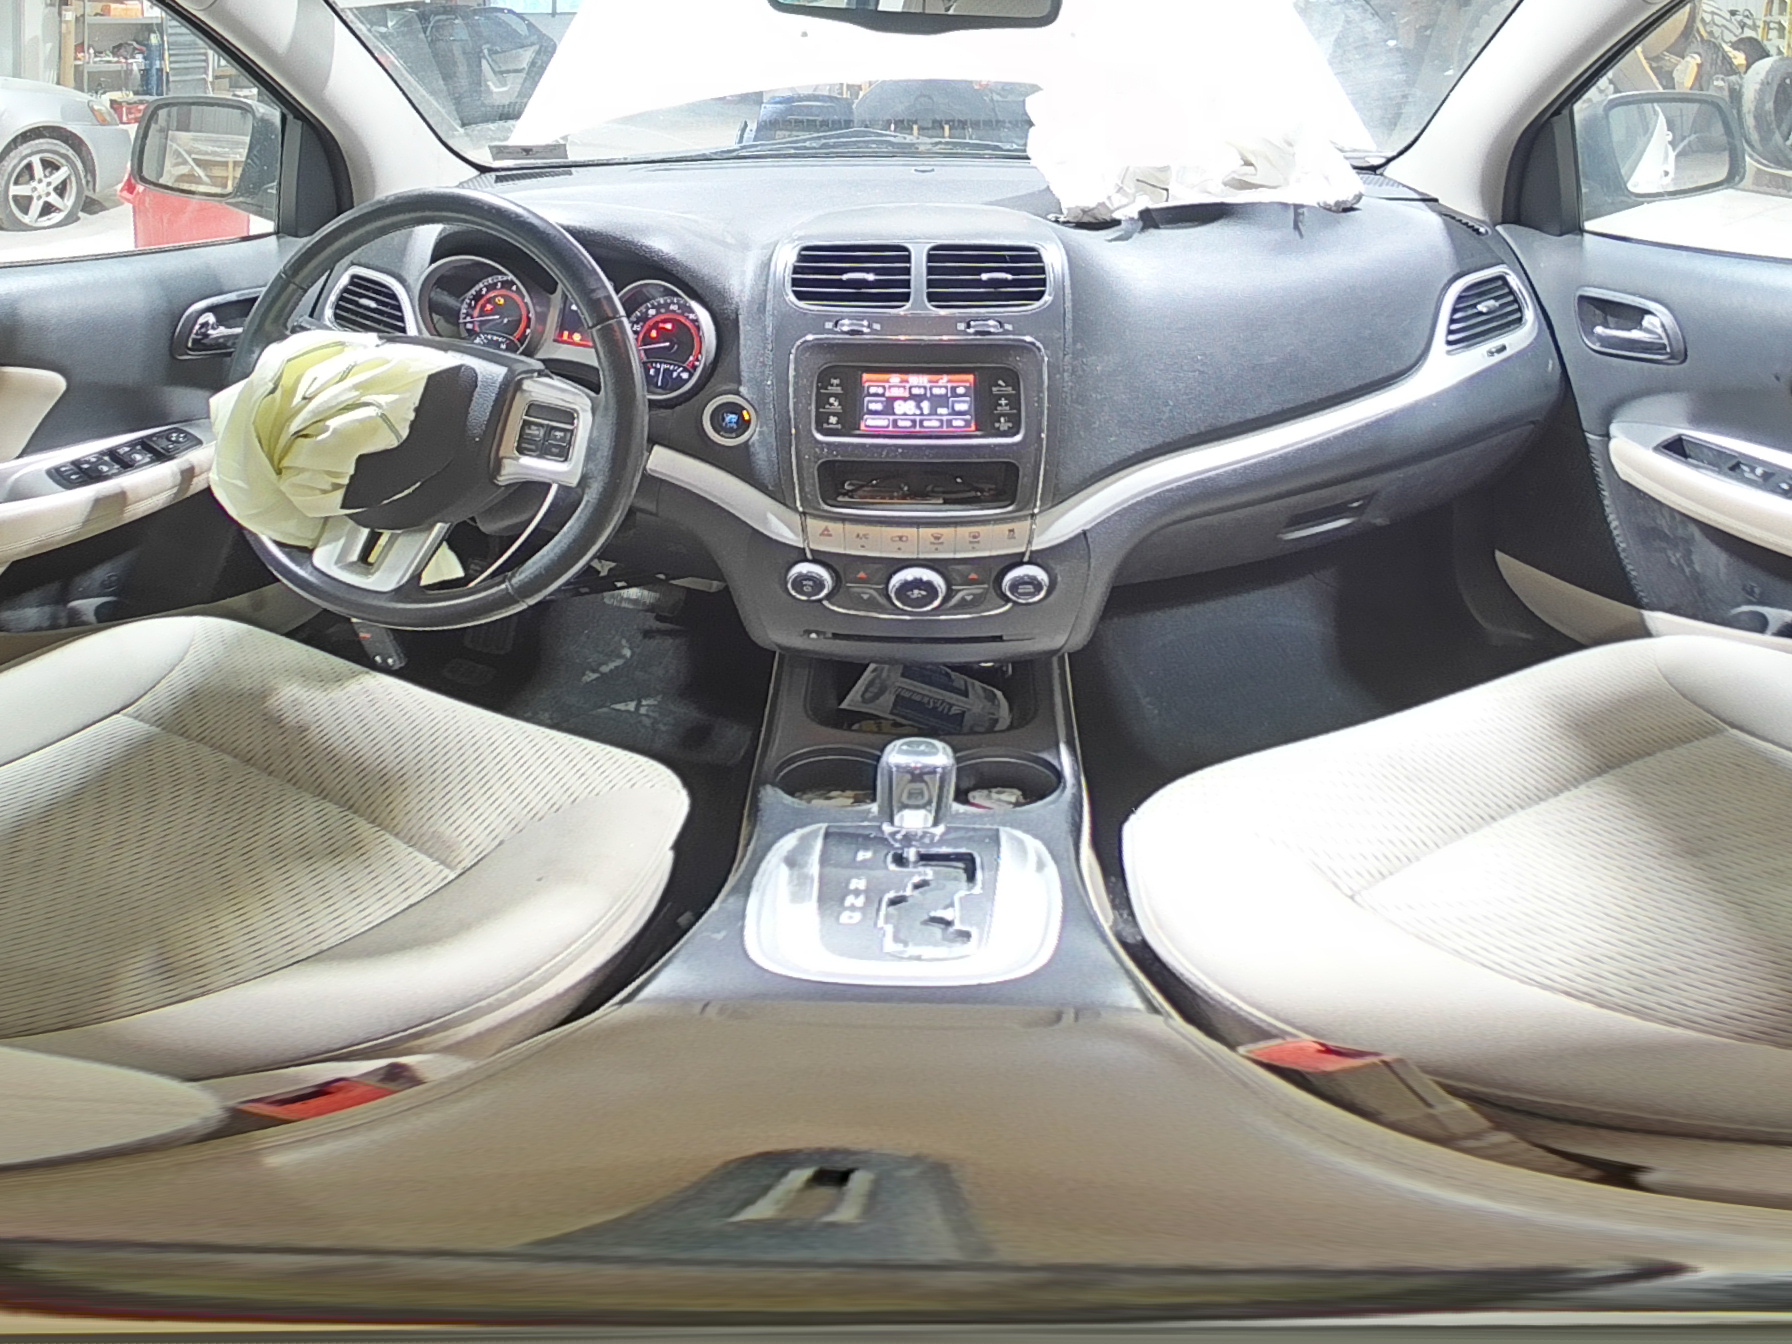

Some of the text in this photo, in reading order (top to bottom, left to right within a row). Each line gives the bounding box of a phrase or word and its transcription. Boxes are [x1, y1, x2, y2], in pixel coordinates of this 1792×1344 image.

[855, 848, 873, 862] P
[844, 893, 866, 908] N
[839, 910, 863, 924] D
